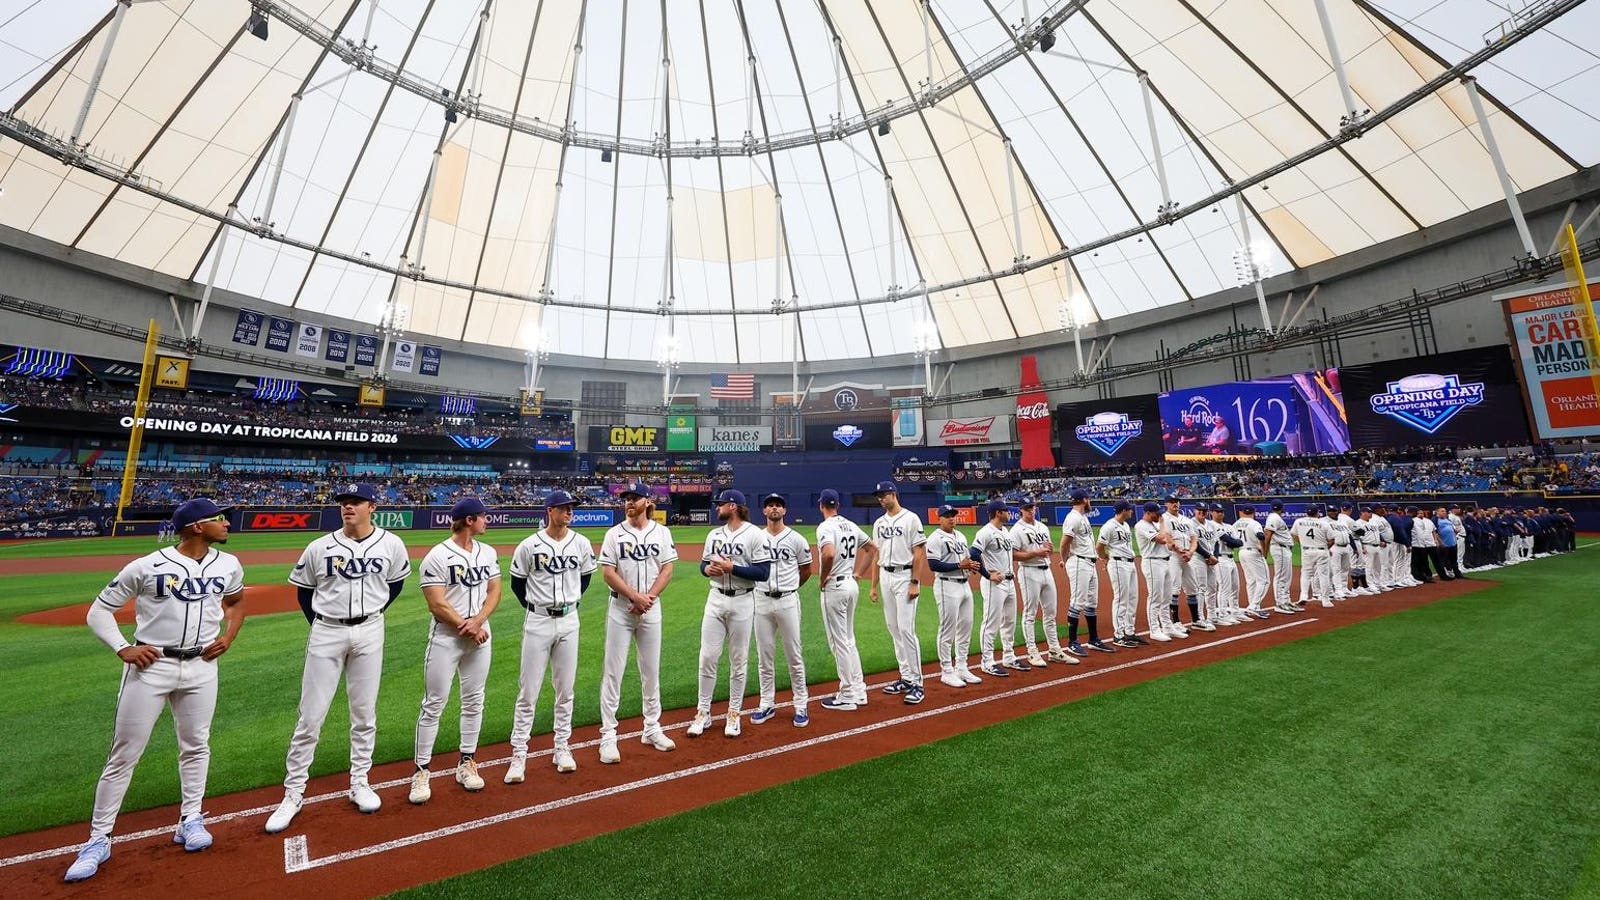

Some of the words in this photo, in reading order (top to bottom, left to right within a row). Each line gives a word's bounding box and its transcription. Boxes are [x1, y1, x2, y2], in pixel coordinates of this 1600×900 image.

[1528, 287, 1580, 303] ORLANDO
[1536, 295, 1576, 308] HEALTH
[1525, 313, 1558, 325] MAJOR
[1559, 308, 1587, 320] LEAGU
[269, 337, 288, 347] 2008
[1373, 389, 1445, 406] OPENING
[1448, 385, 1481, 398] DAY
[1551, 393, 1600, 404] ORLAND
[1388, 400, 1438, 411] TROPICANA
[1440, 398, 1466, 407] FIELD
[1231, 396, 1288, 442] 162
[120, 416, 198, 432] OPENING
[200, 422, 232, 435] DAY
[231, 425, 252, 436] AT
[253, 426, 333, 441] TROPICANA
[334, 431, 369, 443] FIELD
[370, 433, 399, 444] 2026
[711, 428, 760, 442] kanes
[946, 422, 990, 434] Budweiser
[1077, 424, 1120, 435] OPENING
[1121, 422, 1140, 431] DAY
[610, 427, 657, 446] GMF
[251, 513, 312, 529] DEX
[486, 514, 509, 526] OME
[508, 517, 545, 525] MORTGAG
[878, 525, 903, 540] RAYS
[1306, 528, 1315, 540] 4
[617, 541, 660, 562] RAYS
[711, 539, 744, 559] RAYS
[840, 535, 856, 560] 32
[324, 555, 384, 581] RAYS
[532, 552, 579, 575] RAYS
[447, 563, 491, 588] RAYS
[153, 573, 226, 603] RAYS
